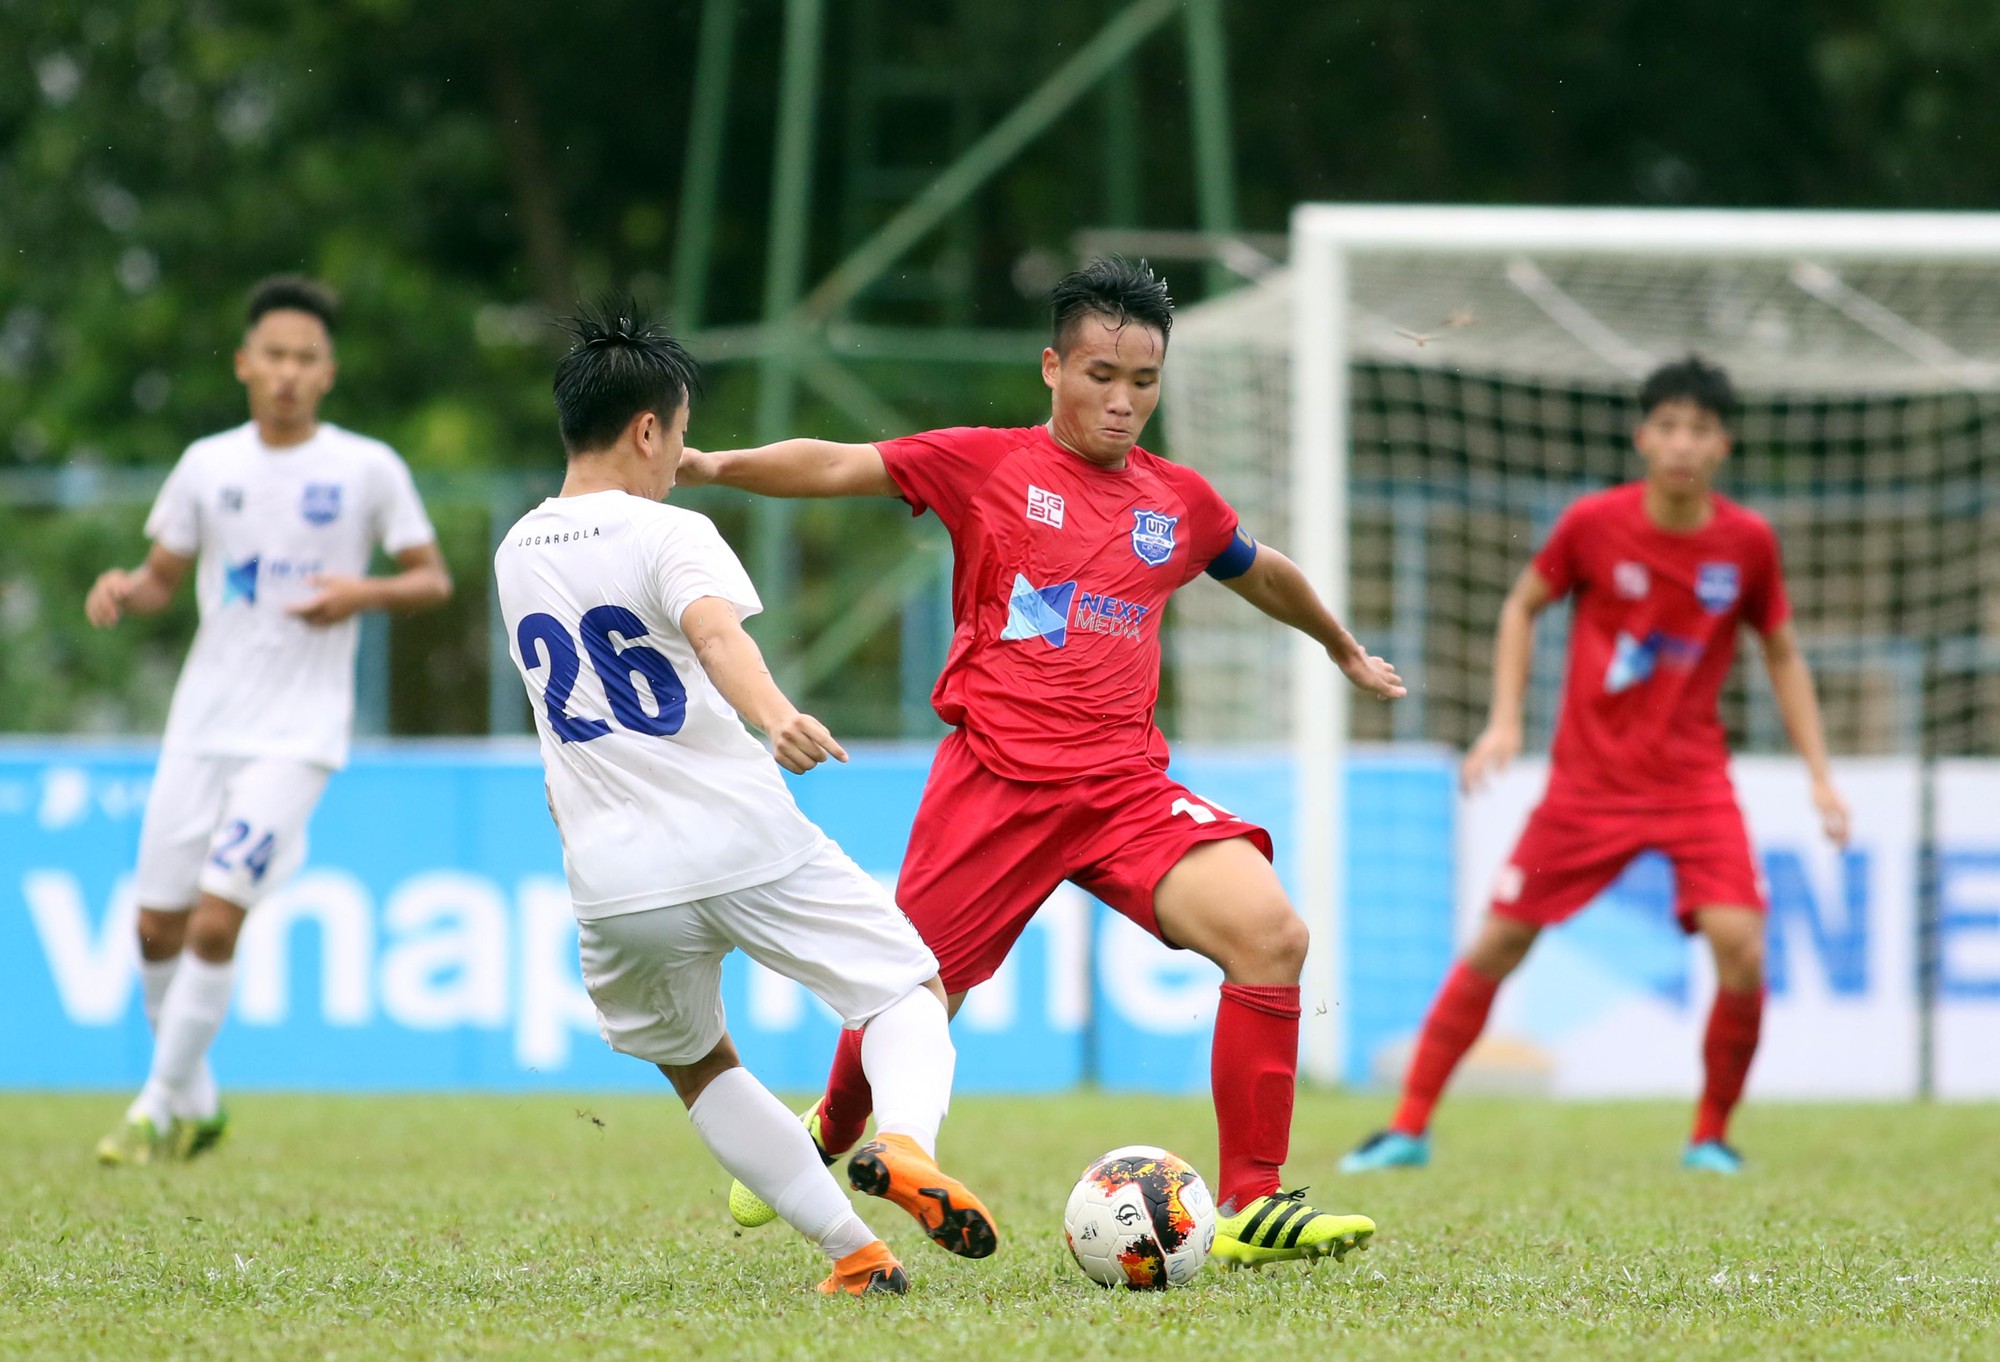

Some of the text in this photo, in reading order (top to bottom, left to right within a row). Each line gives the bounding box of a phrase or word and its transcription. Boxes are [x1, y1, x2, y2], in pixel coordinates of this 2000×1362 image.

[518, 527, 601, 547] JOGARBOLA
[1079, 592, 1149, 623] NEXT
[1074, 609, 1141, 642] MEDIA
[517, 605, 688, 744] 26
[1171, 794, 1243, 824] 1
[210, 820, 276, 885] 24
